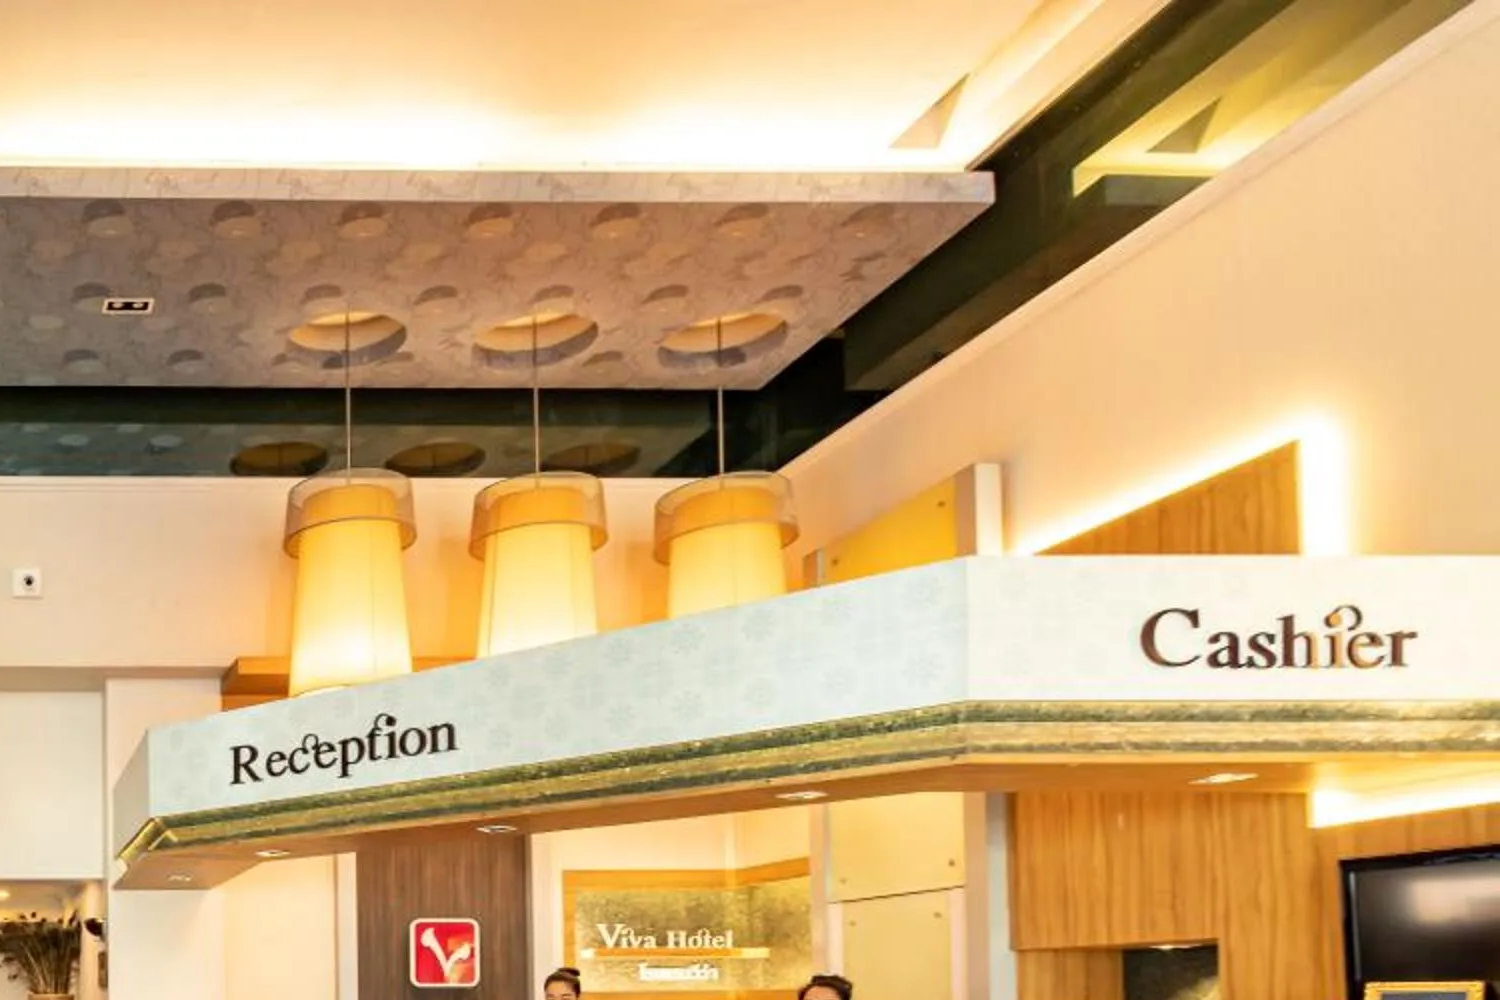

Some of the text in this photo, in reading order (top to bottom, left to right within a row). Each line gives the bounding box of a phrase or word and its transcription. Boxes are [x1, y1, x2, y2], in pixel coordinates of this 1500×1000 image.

[1140, 604, 1419, 669] Cashier
[230, 713, 459, 785] Reception
[595, 922, 734, 949] Viva Hotel
